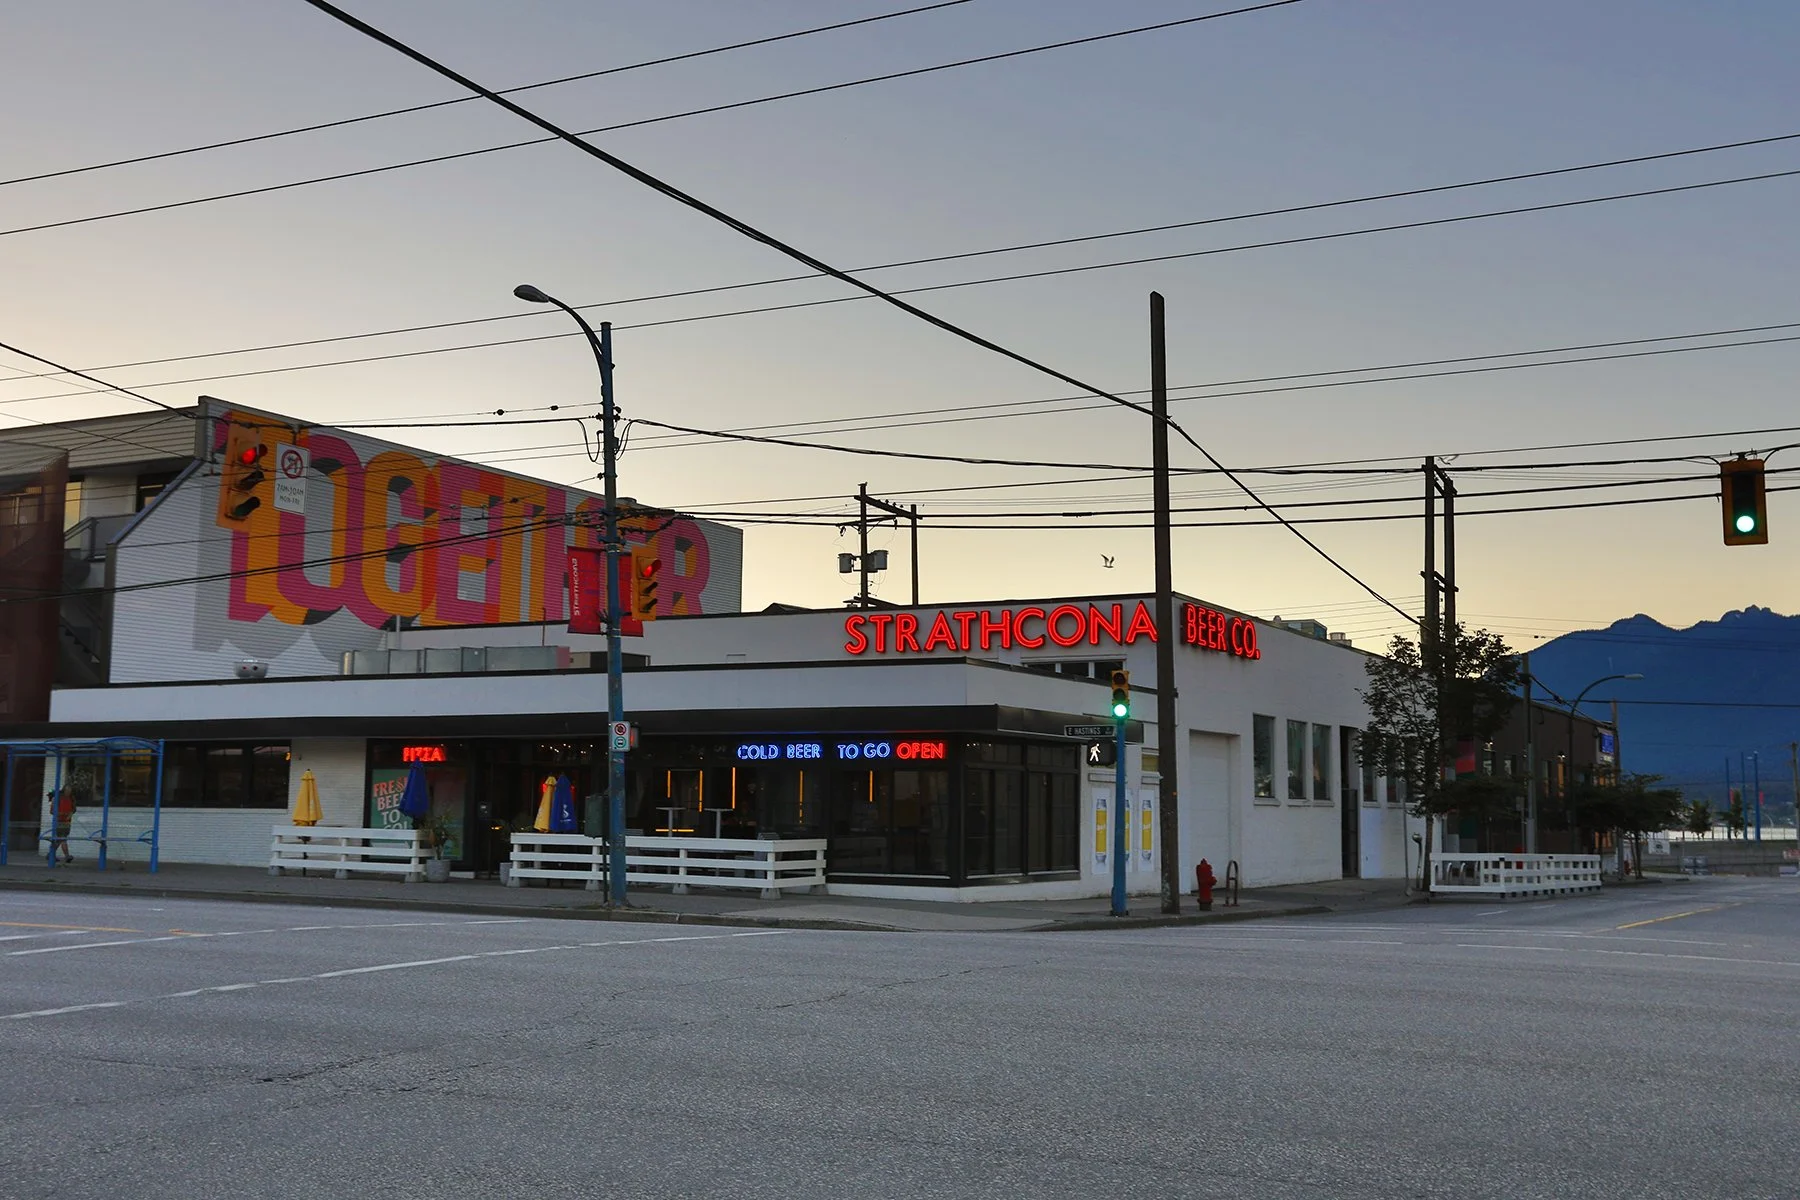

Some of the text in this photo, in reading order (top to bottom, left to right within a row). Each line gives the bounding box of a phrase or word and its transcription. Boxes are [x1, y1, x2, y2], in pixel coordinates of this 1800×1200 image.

[844, 600, 1158, 655] STRATHCONA
[1184, 603, 1261, 659] BEER CO.
[1074, 727, 1101, 735] HASTINGS
[403, 746, 445, 762] PIZZA
[737, 742, 944, 760] COLD BEER TO GO OPEN
[380, 808, 401, 825] TO
